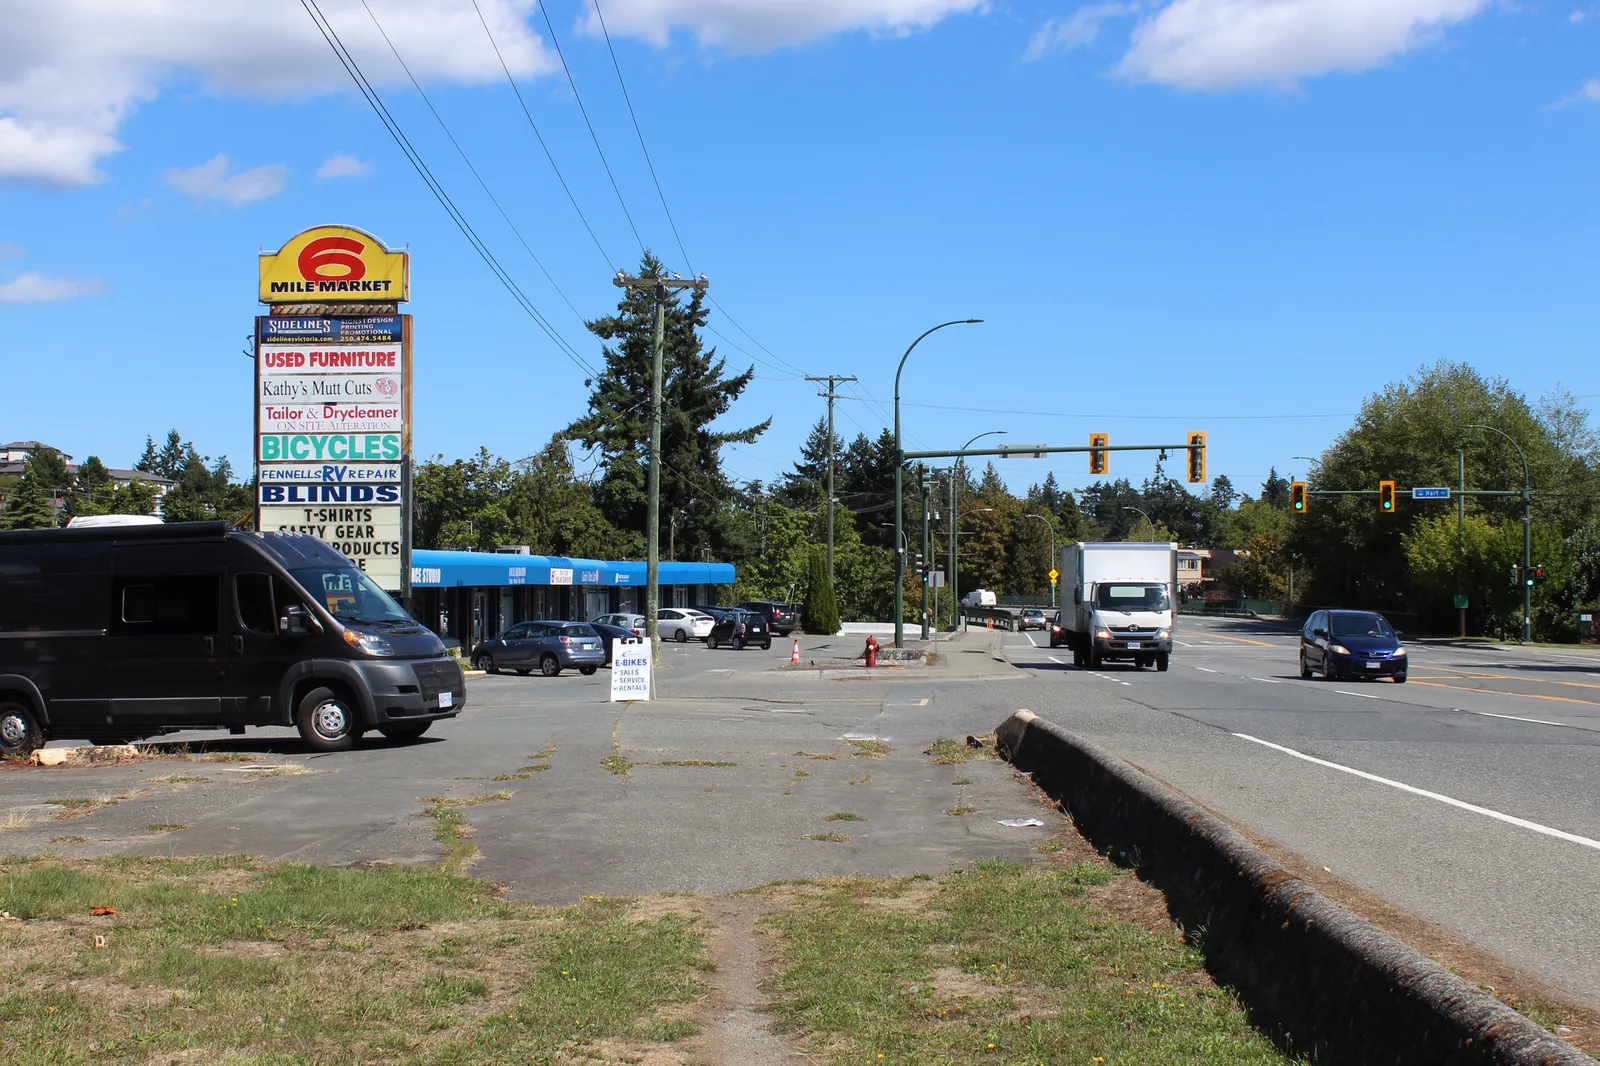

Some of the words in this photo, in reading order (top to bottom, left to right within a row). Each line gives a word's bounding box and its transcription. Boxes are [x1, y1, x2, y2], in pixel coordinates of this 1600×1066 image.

[298, 236, 366, 286] 6
[270, 280, 315, 293] MILE
[319, 280, 392, 292] MARKET
[269, 319, 331, 333] SIDELINES
[265, 352, 306, 368] USED
[309, 351, 396, 367] FURNITURE
[263, 380, 308, 400] Kathy's
[312, 380, 341, 395] Mutt
[344, 379, 372, 395] Cuts
[266, 406, 303, 420] Tailor
[306, 408, 319, 420] &
[323, 405, 399, 421] Drycleaner
[277, 421, 296, 431] ON
[299, 421, 325, 431] SITE
[327, 420, 391, 431] ALTERATION
[262, 435, 400, 460] BICYCLES
[262, 469, 322, 479] FENNELLS
[322, 465, 348, 482] RV
[349, 469, 397, 479] REPAIR
[262, 485, 399, 502] BLINDS
[304, 508, 372, 522] T-SHIRTS
[335, 525, 375, 539] GEAR
[615, 658, 648, 667] E-BIKES
